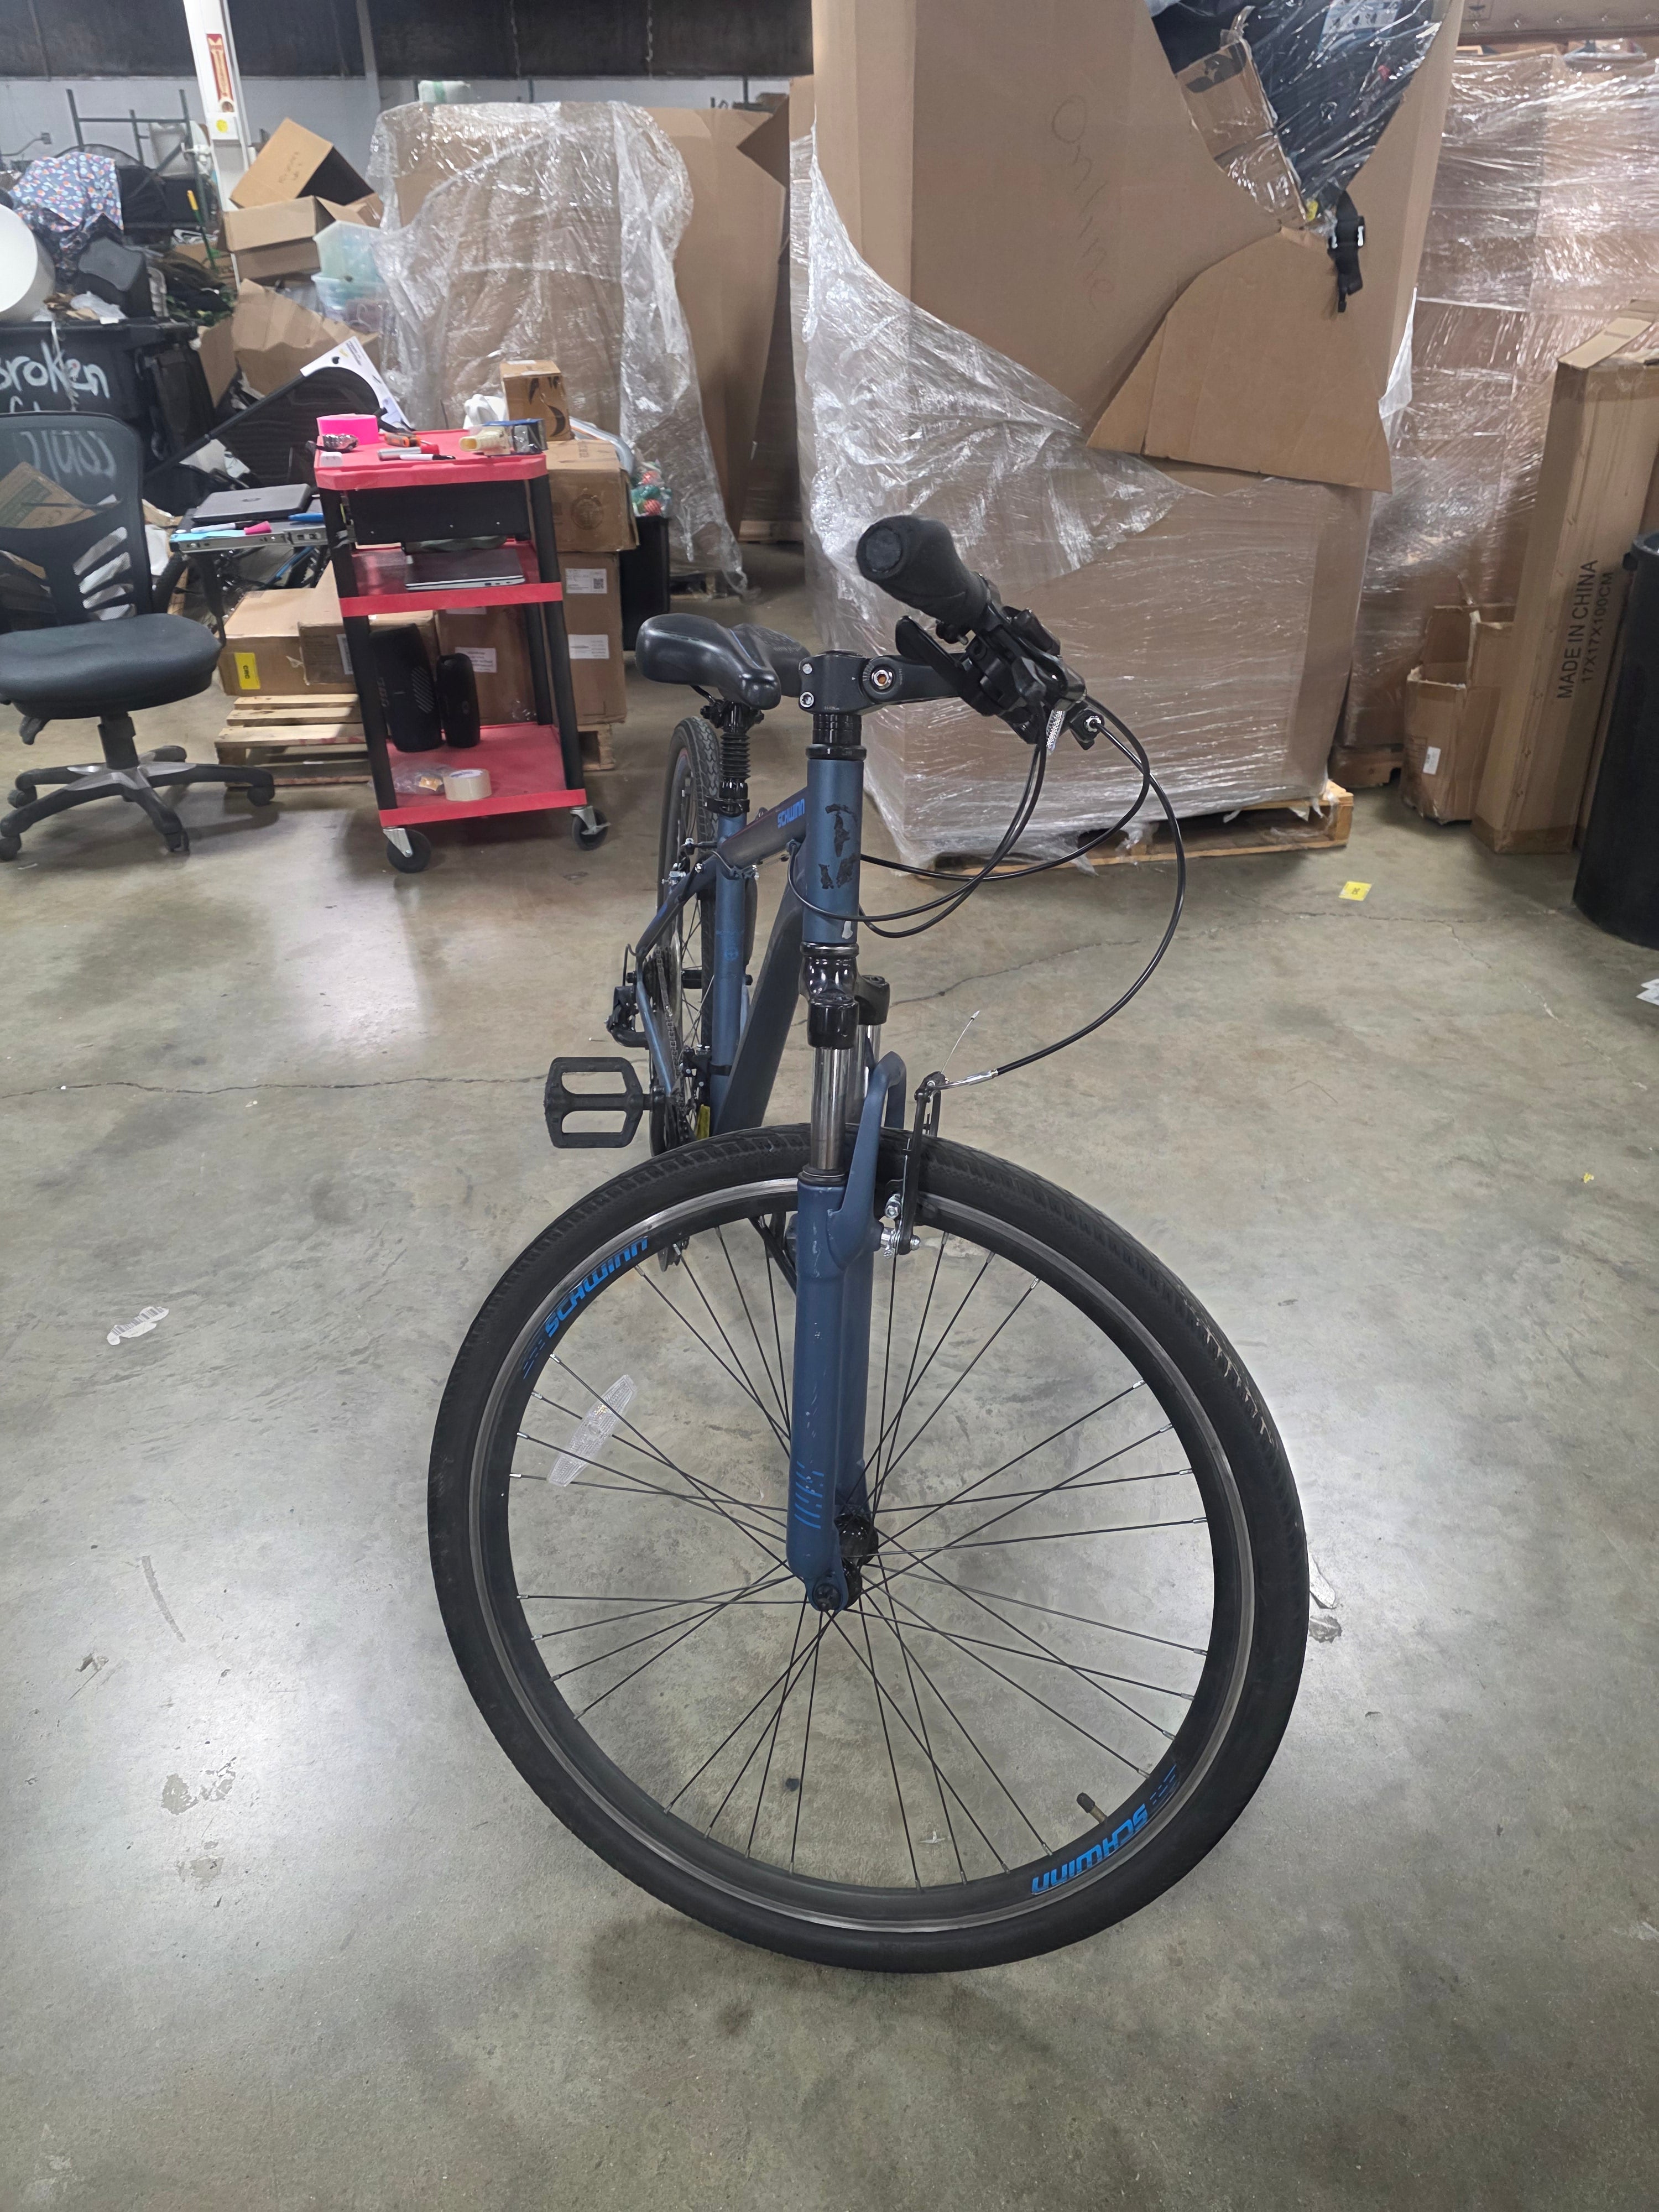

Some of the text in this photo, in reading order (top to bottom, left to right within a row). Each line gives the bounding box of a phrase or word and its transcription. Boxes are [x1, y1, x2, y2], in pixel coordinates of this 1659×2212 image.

[1557, 560, 1598, 699] MADE IN CHINA
[1582, 572, 1614, 683] 17X17X100CM
